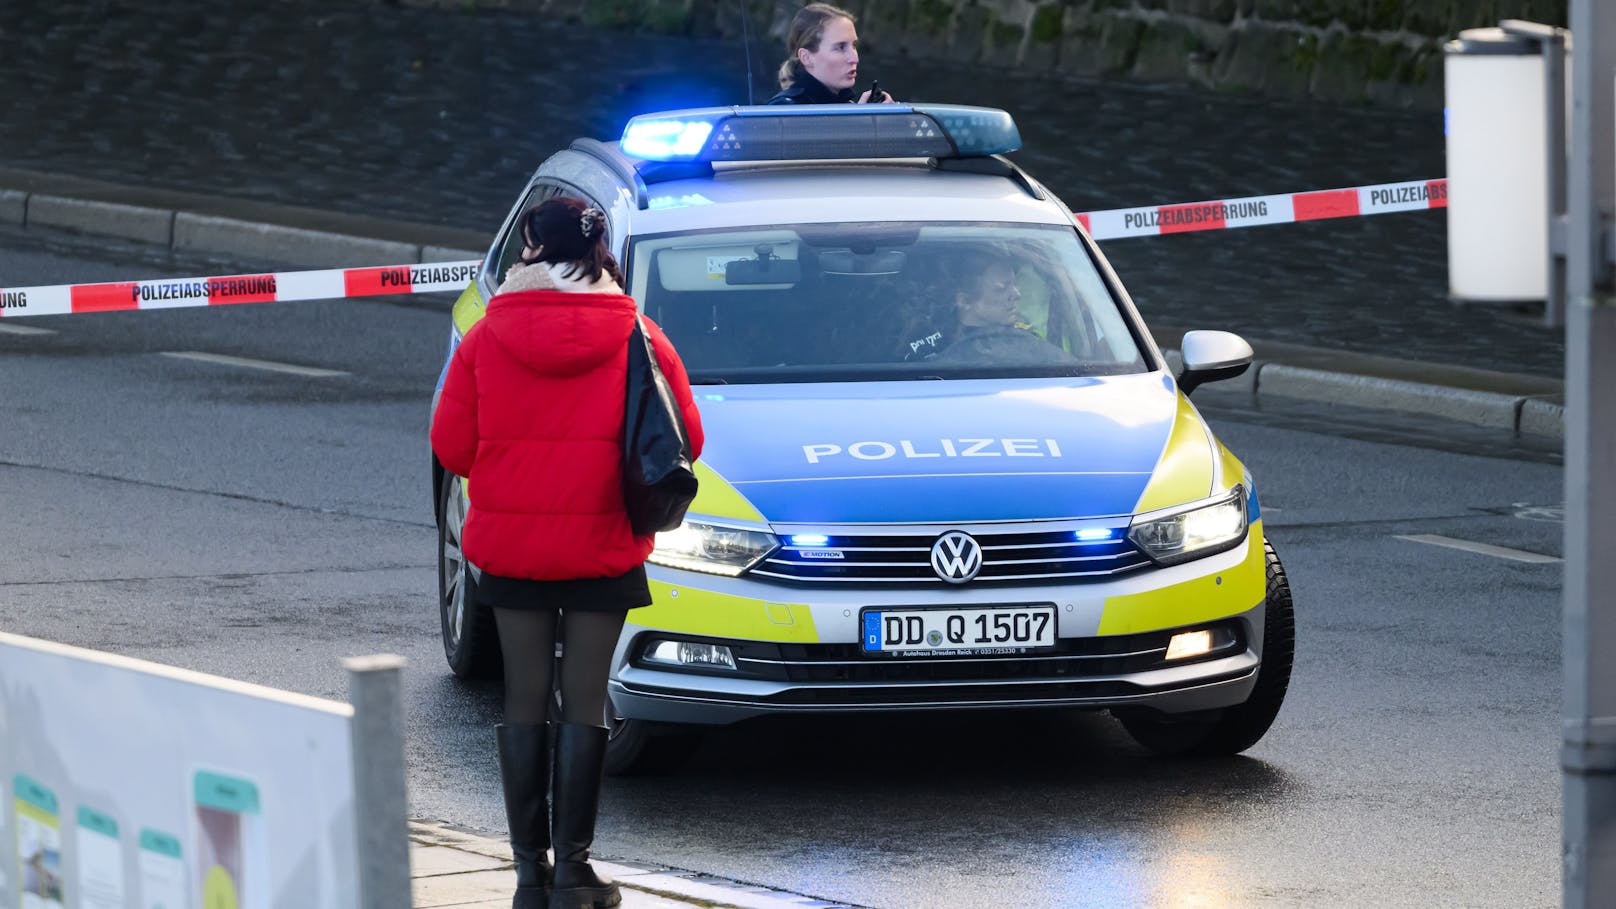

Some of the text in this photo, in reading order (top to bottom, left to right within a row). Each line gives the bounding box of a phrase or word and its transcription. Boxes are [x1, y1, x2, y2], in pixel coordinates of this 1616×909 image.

[1371, 183, 1447, 206] POLIZEIABS
[1124, 201, 1268, 229] POLIZEIABSPERRUNG
[381, 265, 480, 287] POLIZEIABSPE
[132, 277, 277, 302] POLIZEIABSPERRUNG
[802, 438, 1062, 464] POLIZEI
[869, 636, 877, 644] D
[884, 612, 1050, 646] DD Q 1507
